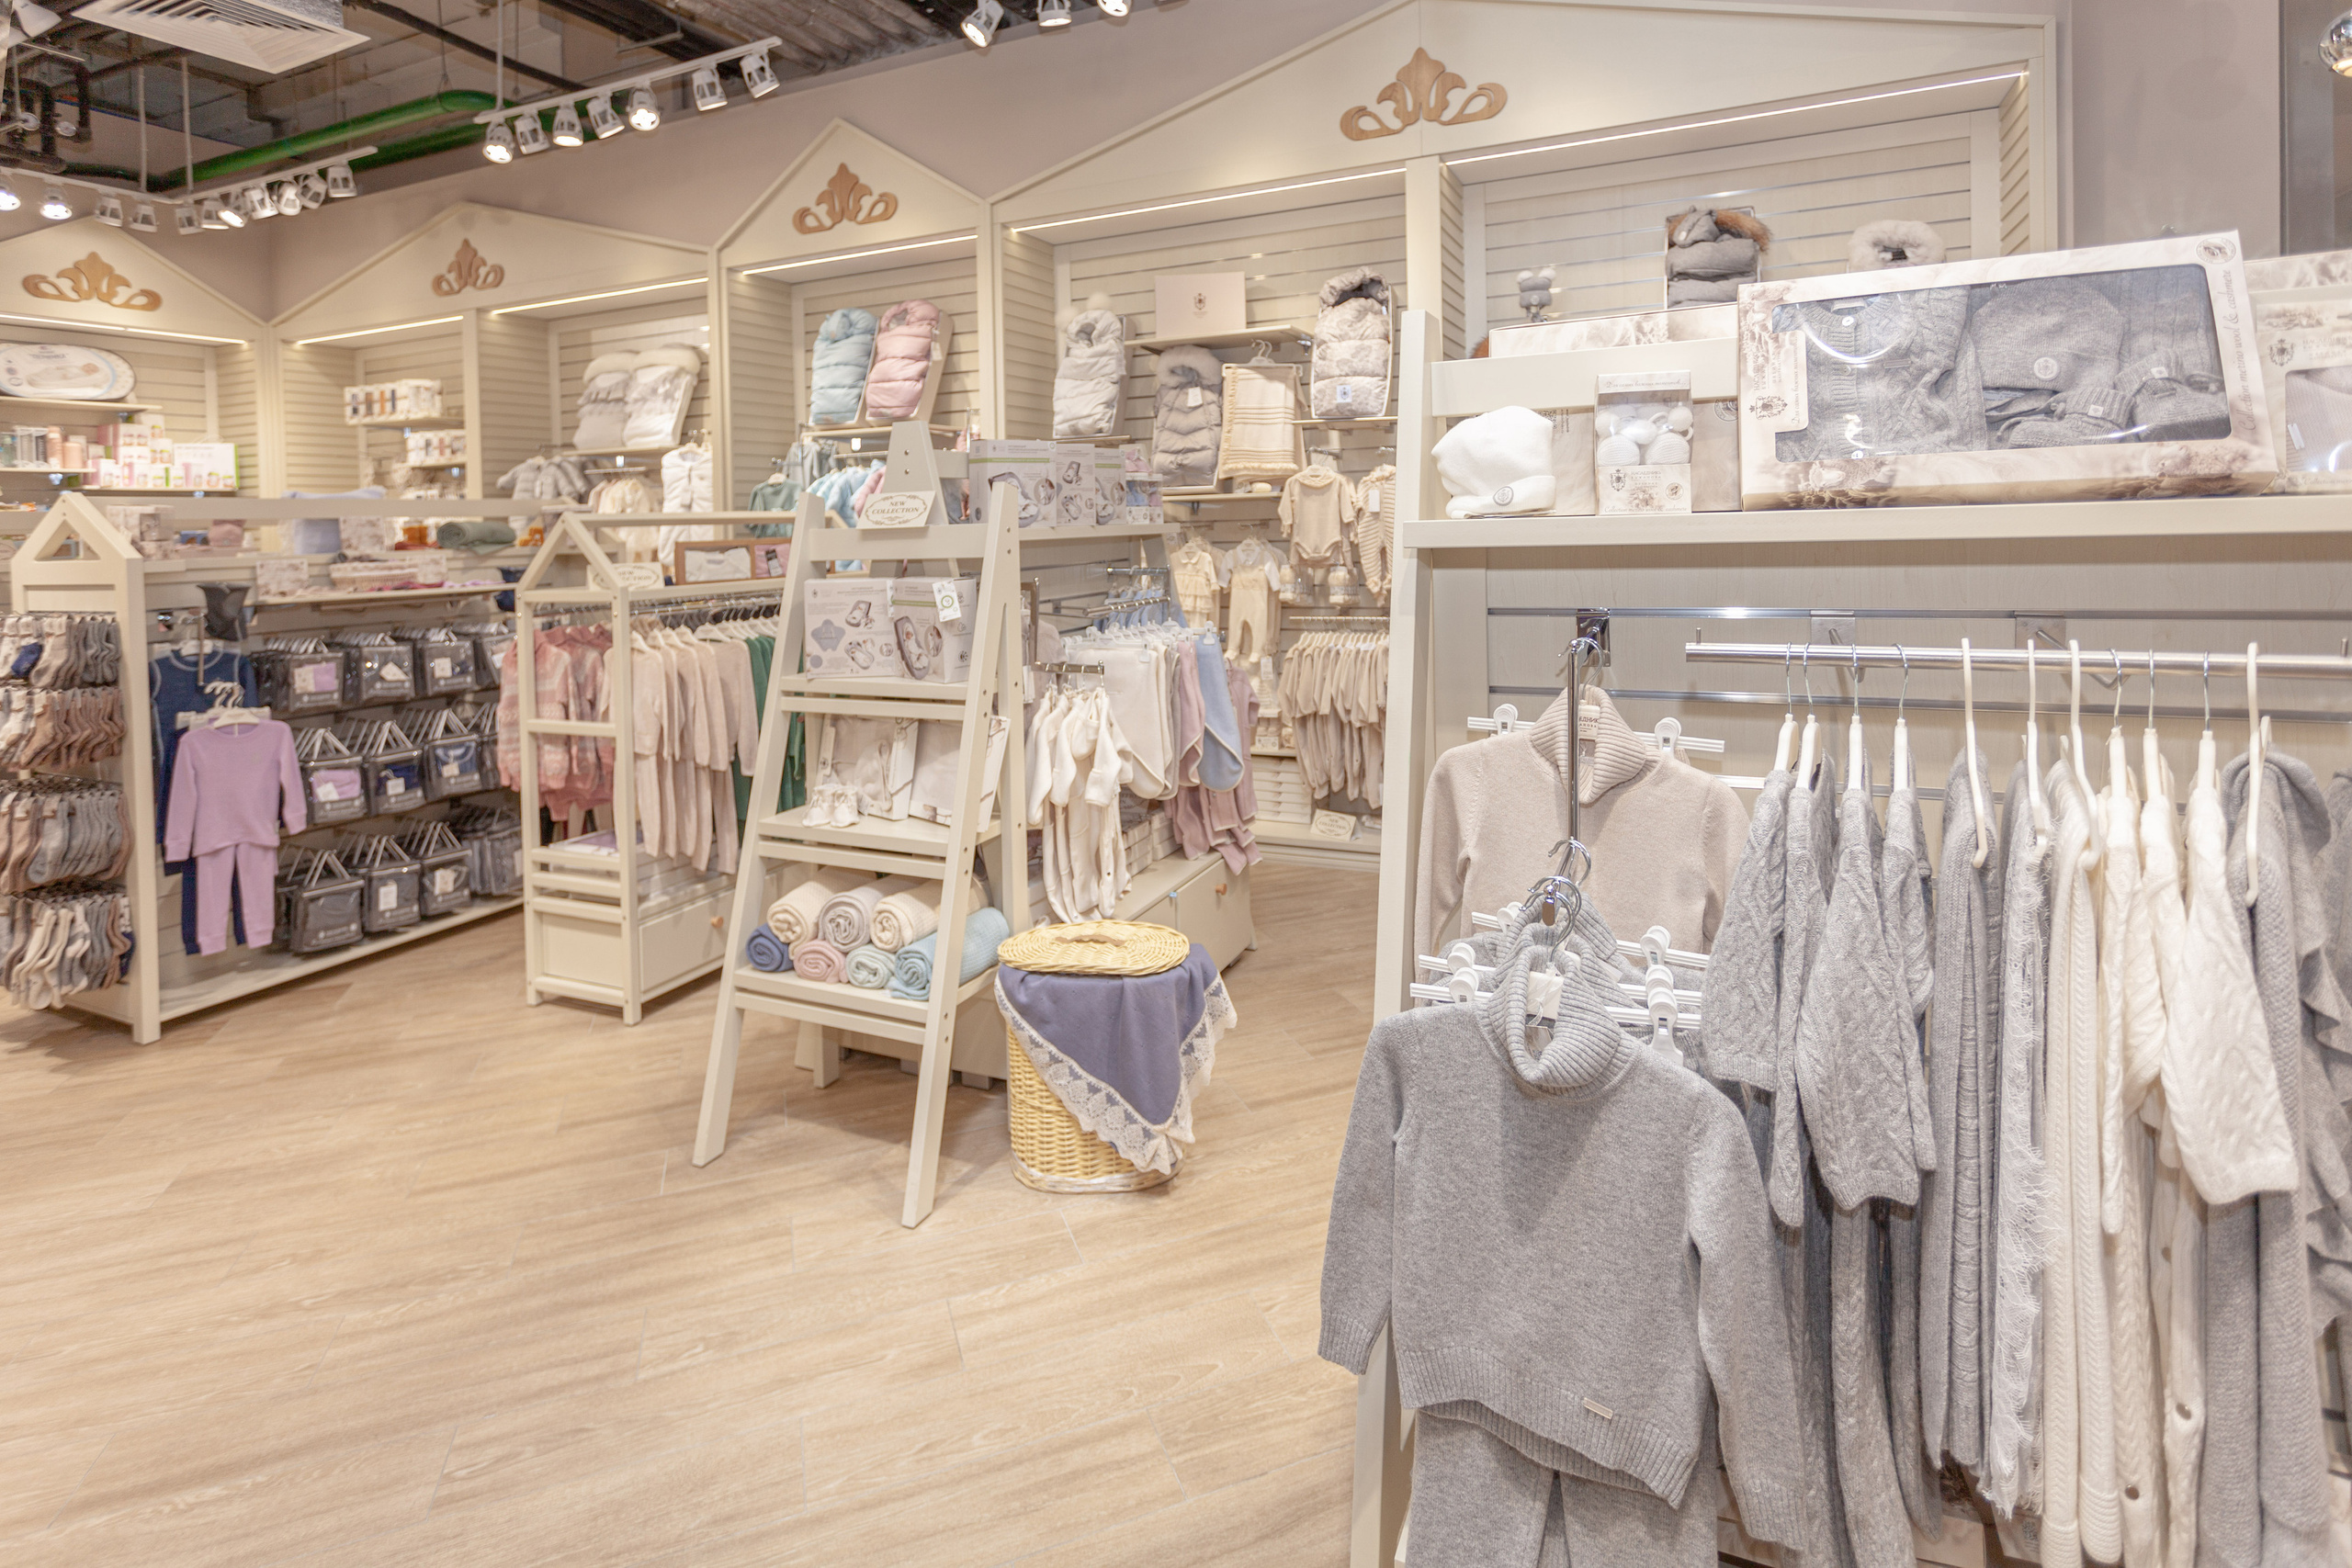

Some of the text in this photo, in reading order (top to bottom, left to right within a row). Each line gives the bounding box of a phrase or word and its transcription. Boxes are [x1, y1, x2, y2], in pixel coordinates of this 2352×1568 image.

[2217, 269, 2257, 431] Collection merino wool & cashmere
[1604, 505, 1627, 513] Collection
